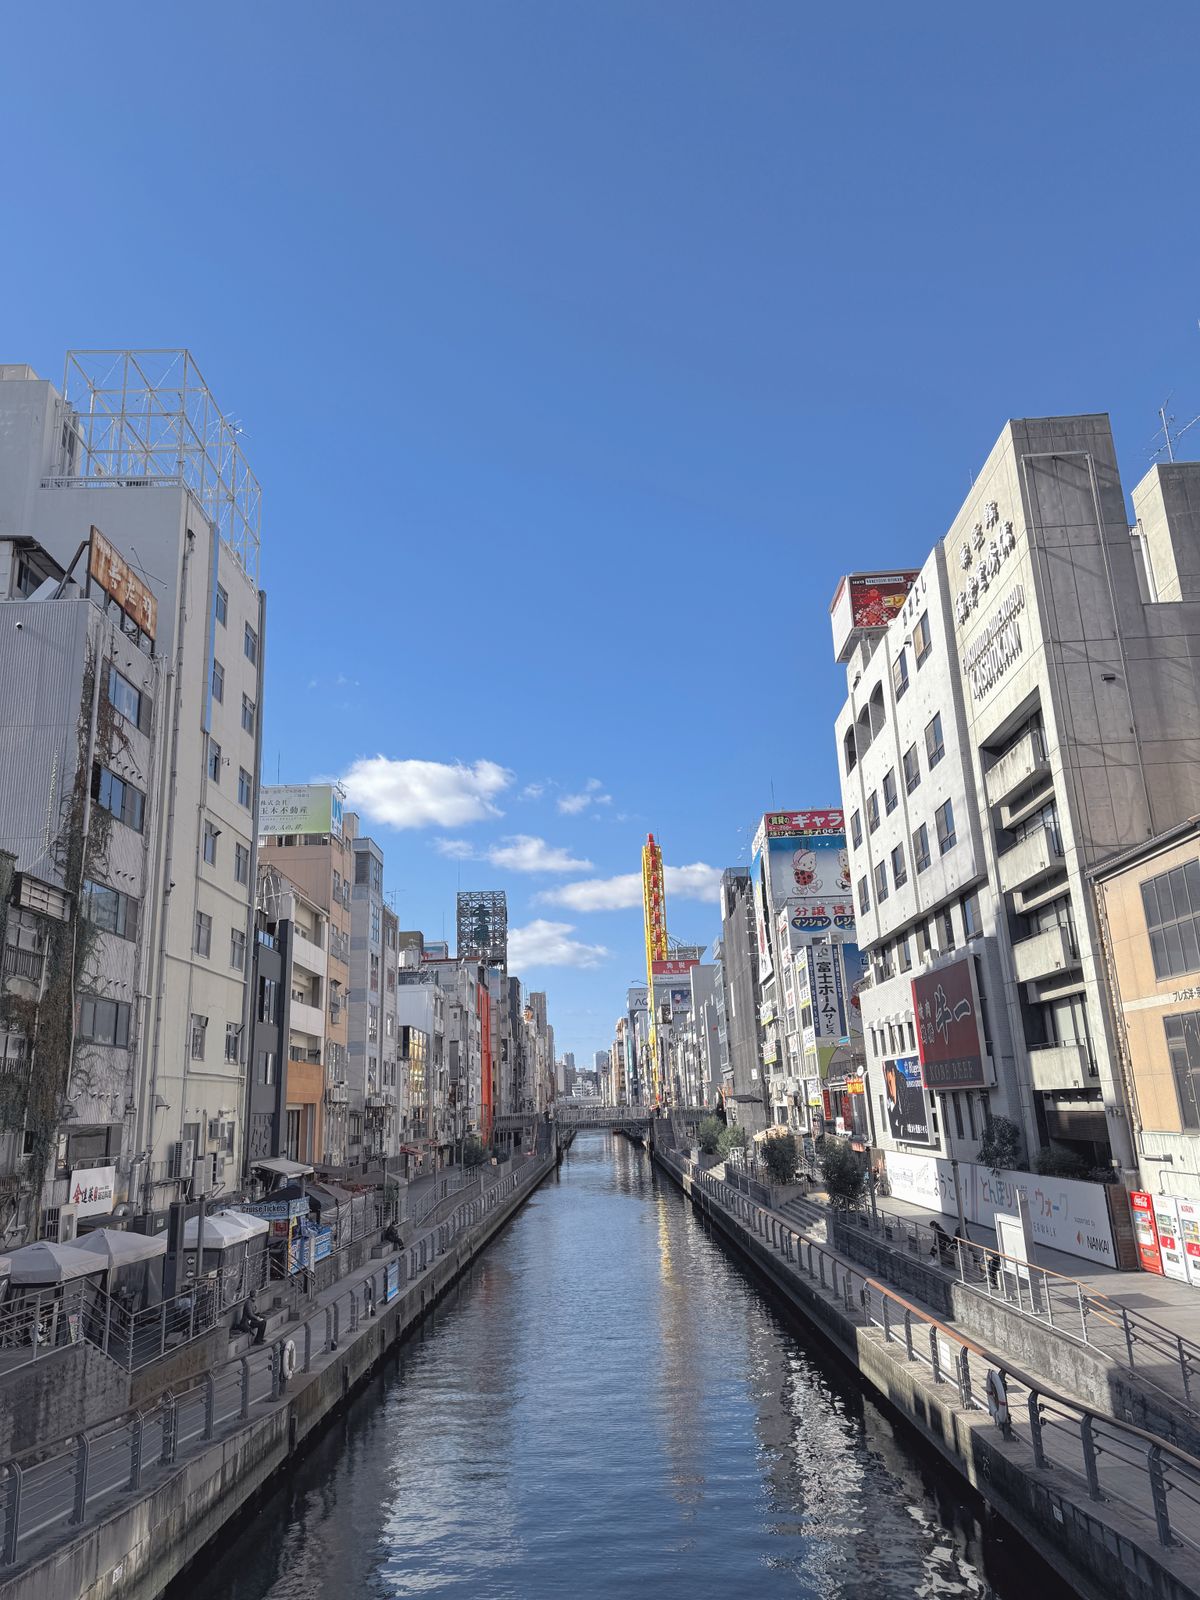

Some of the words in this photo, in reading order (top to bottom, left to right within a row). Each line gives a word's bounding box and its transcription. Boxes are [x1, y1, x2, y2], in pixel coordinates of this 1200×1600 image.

[971, 621, 1023, 701] KASHUKAN
[793, 918, 830, 927] マンション
[816, 961, 837, 1035] 富士ホームサービス
[929, 1062, 950, 1081] KOBE
[951, 1060, 973, 1080] BEEF
[241, 1205, 263, 1214] Cruise
[263, 1204, 287, 1213] Tickets
[1086, 1235, 1111, 1254] NANKAI
